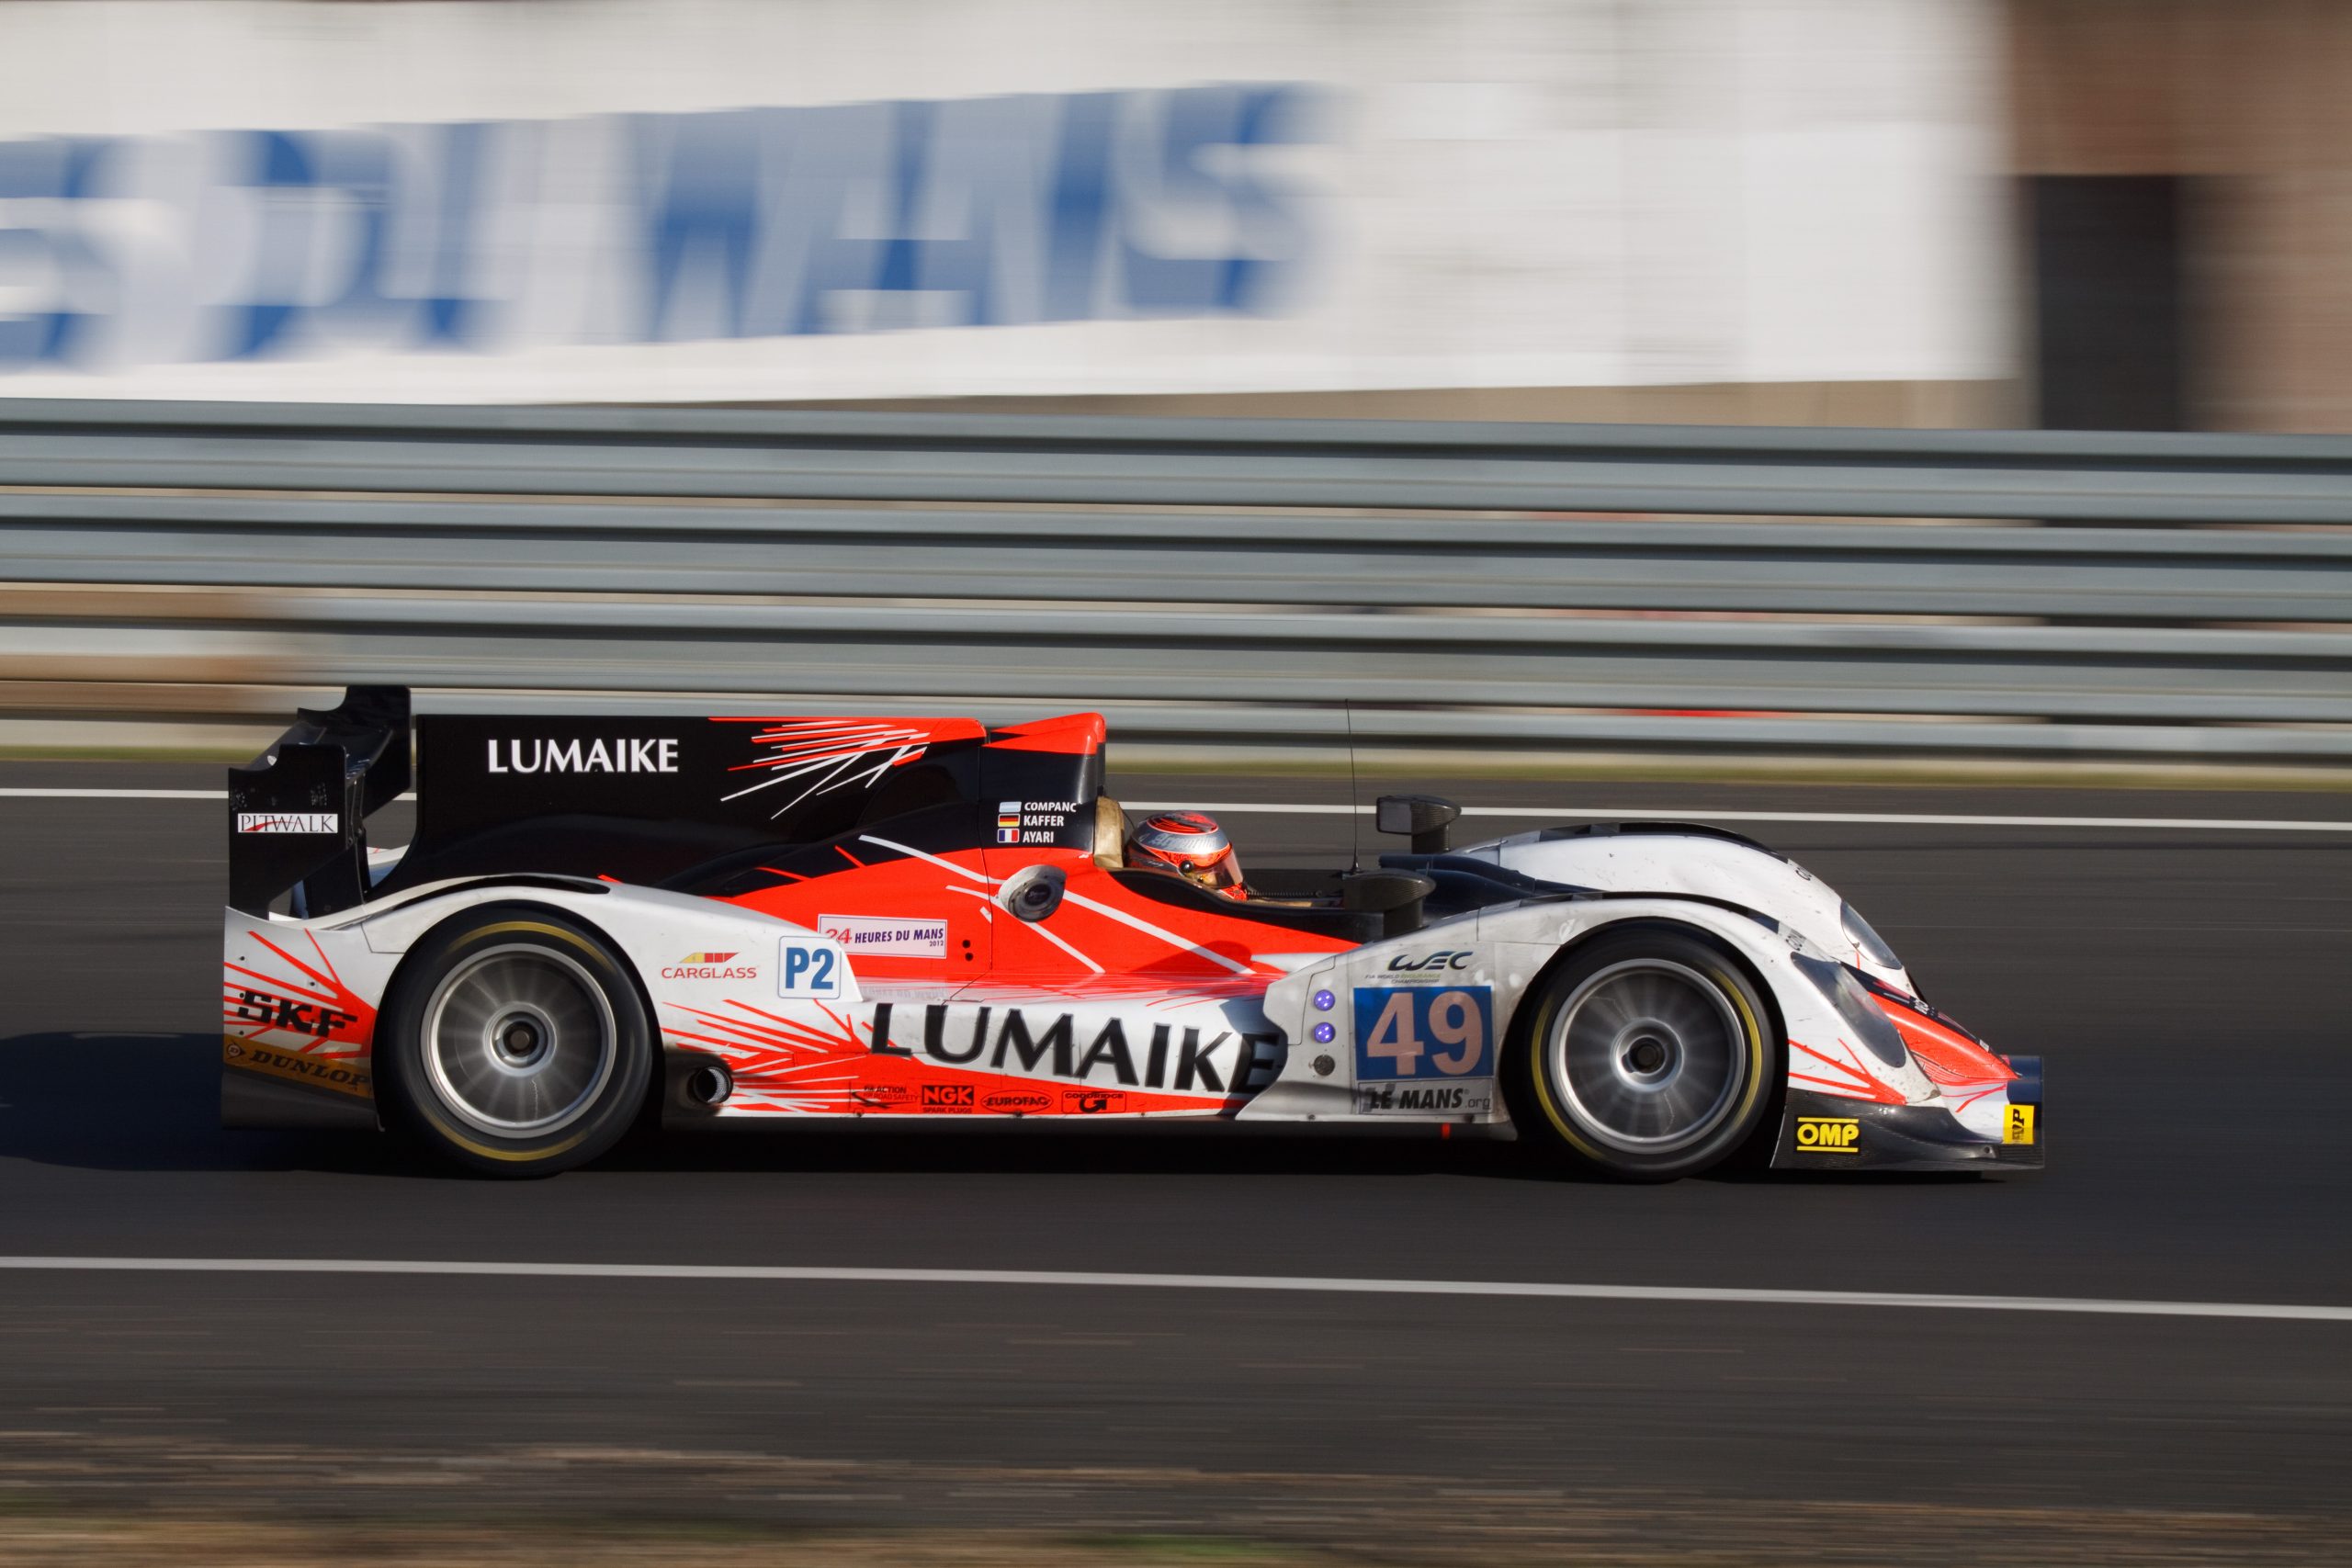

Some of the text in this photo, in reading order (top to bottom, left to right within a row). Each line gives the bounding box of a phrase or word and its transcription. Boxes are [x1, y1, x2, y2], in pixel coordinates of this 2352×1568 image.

[488, 738, 679, 773] LUMAIKE
[1023, 801, 1077, 813] COMPANC
[240, 814, 334, 832] PITWALK
[1023, 815, 1065, 827] KAFFER
[1022, 831, 1055, 843] AYARI
[824, 928, 944, 944] 24 HEURES DU MANS
[785, 946, 835, 990] P2
[1387, 950, 1474, 971] WEC
[661, 967, 758, 979] CARGLASS
[237, 990, 358, 1038] SKF
[1366, 990, 1484, 1077] 49
[871, 1002, 1280, 1094] LUMAIKE
[249, 1049, 371, 1087] DUNLOP
[874, 1092, 893, 1100] ROAD
[893, 1093, 919, 1101] SAFETY
[875, 1086, 907, 1094] ACTION
[923, 1087, 973, 1105] NGK
[1369, 1089, 1395, 1110] LE
[1398, 1088, 1464, 1110] MANS
[1796, 1122, 1860, 1146] OMP
